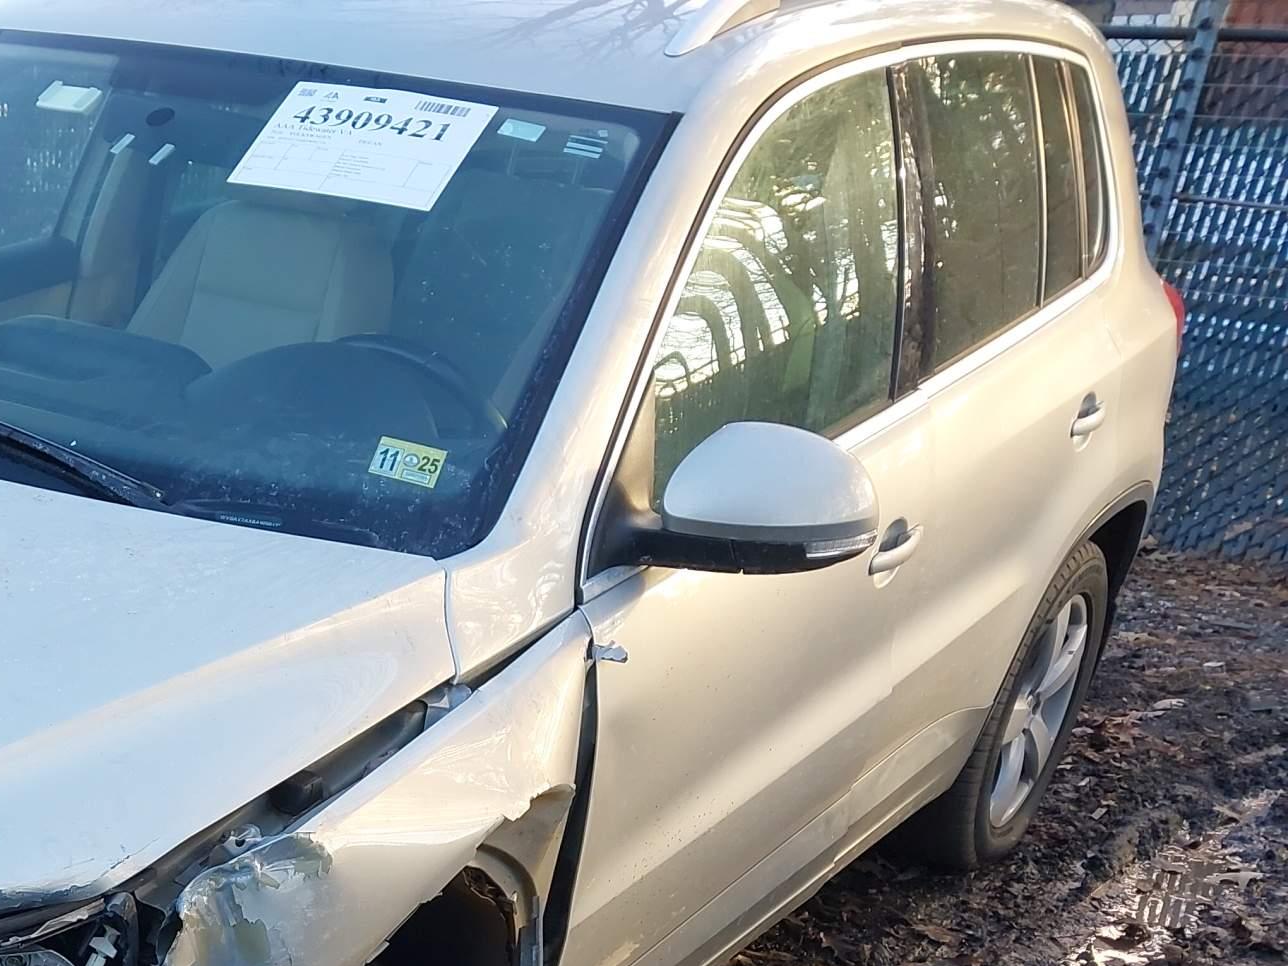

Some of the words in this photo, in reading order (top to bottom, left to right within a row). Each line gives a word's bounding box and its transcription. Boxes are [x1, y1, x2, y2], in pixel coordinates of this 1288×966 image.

[292, 105, 452, 141] 43909421
[379, 447, 400, 472] 11
[417, 455, 441, 474] 25
